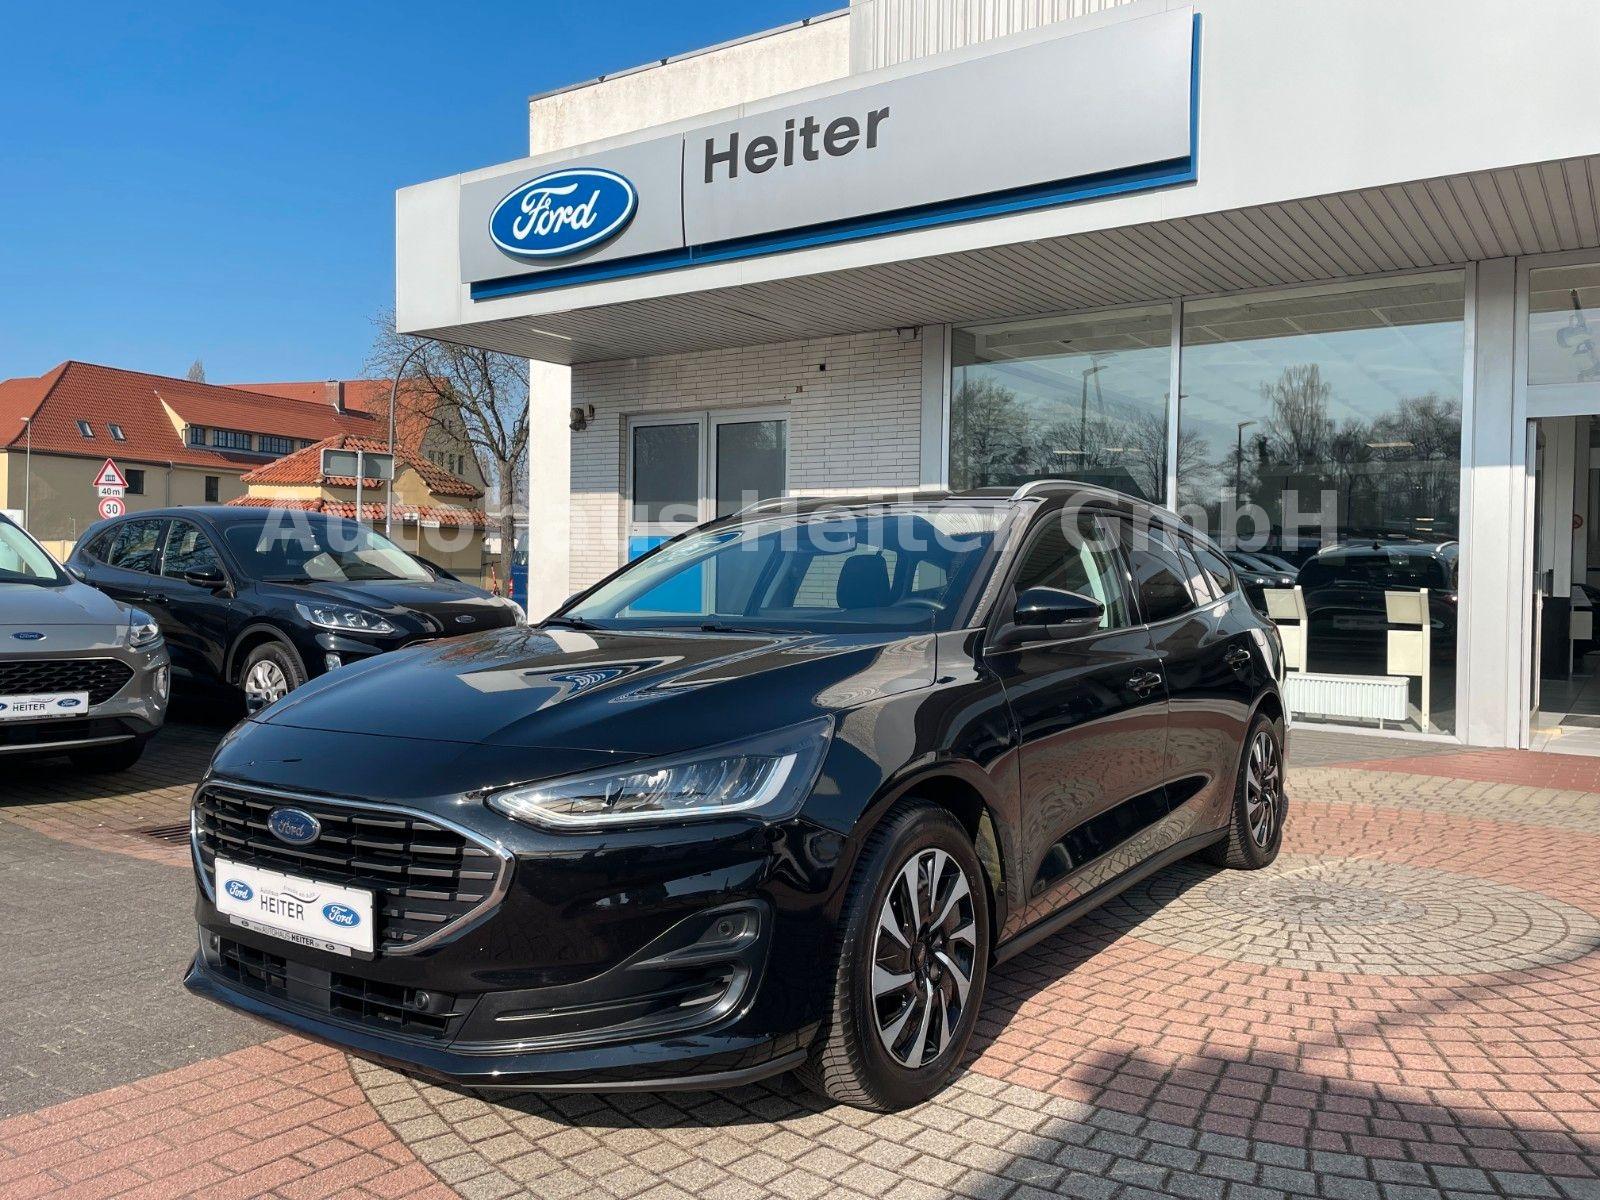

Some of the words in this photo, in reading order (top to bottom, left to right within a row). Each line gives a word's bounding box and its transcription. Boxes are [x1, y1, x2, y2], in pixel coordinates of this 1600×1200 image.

[704, 106, 890, 184] Heiter
[512, 182, 601, 240] Ford
[105, 504, 118, 514] 30
[13, 703, 46, 711] HEITER
[277, 818, 305, 838] Ford
[229, 881, 249, 899] Ford
[260, 895, 304, 920] HEITER
[328, 905, 354, 925] Ford
